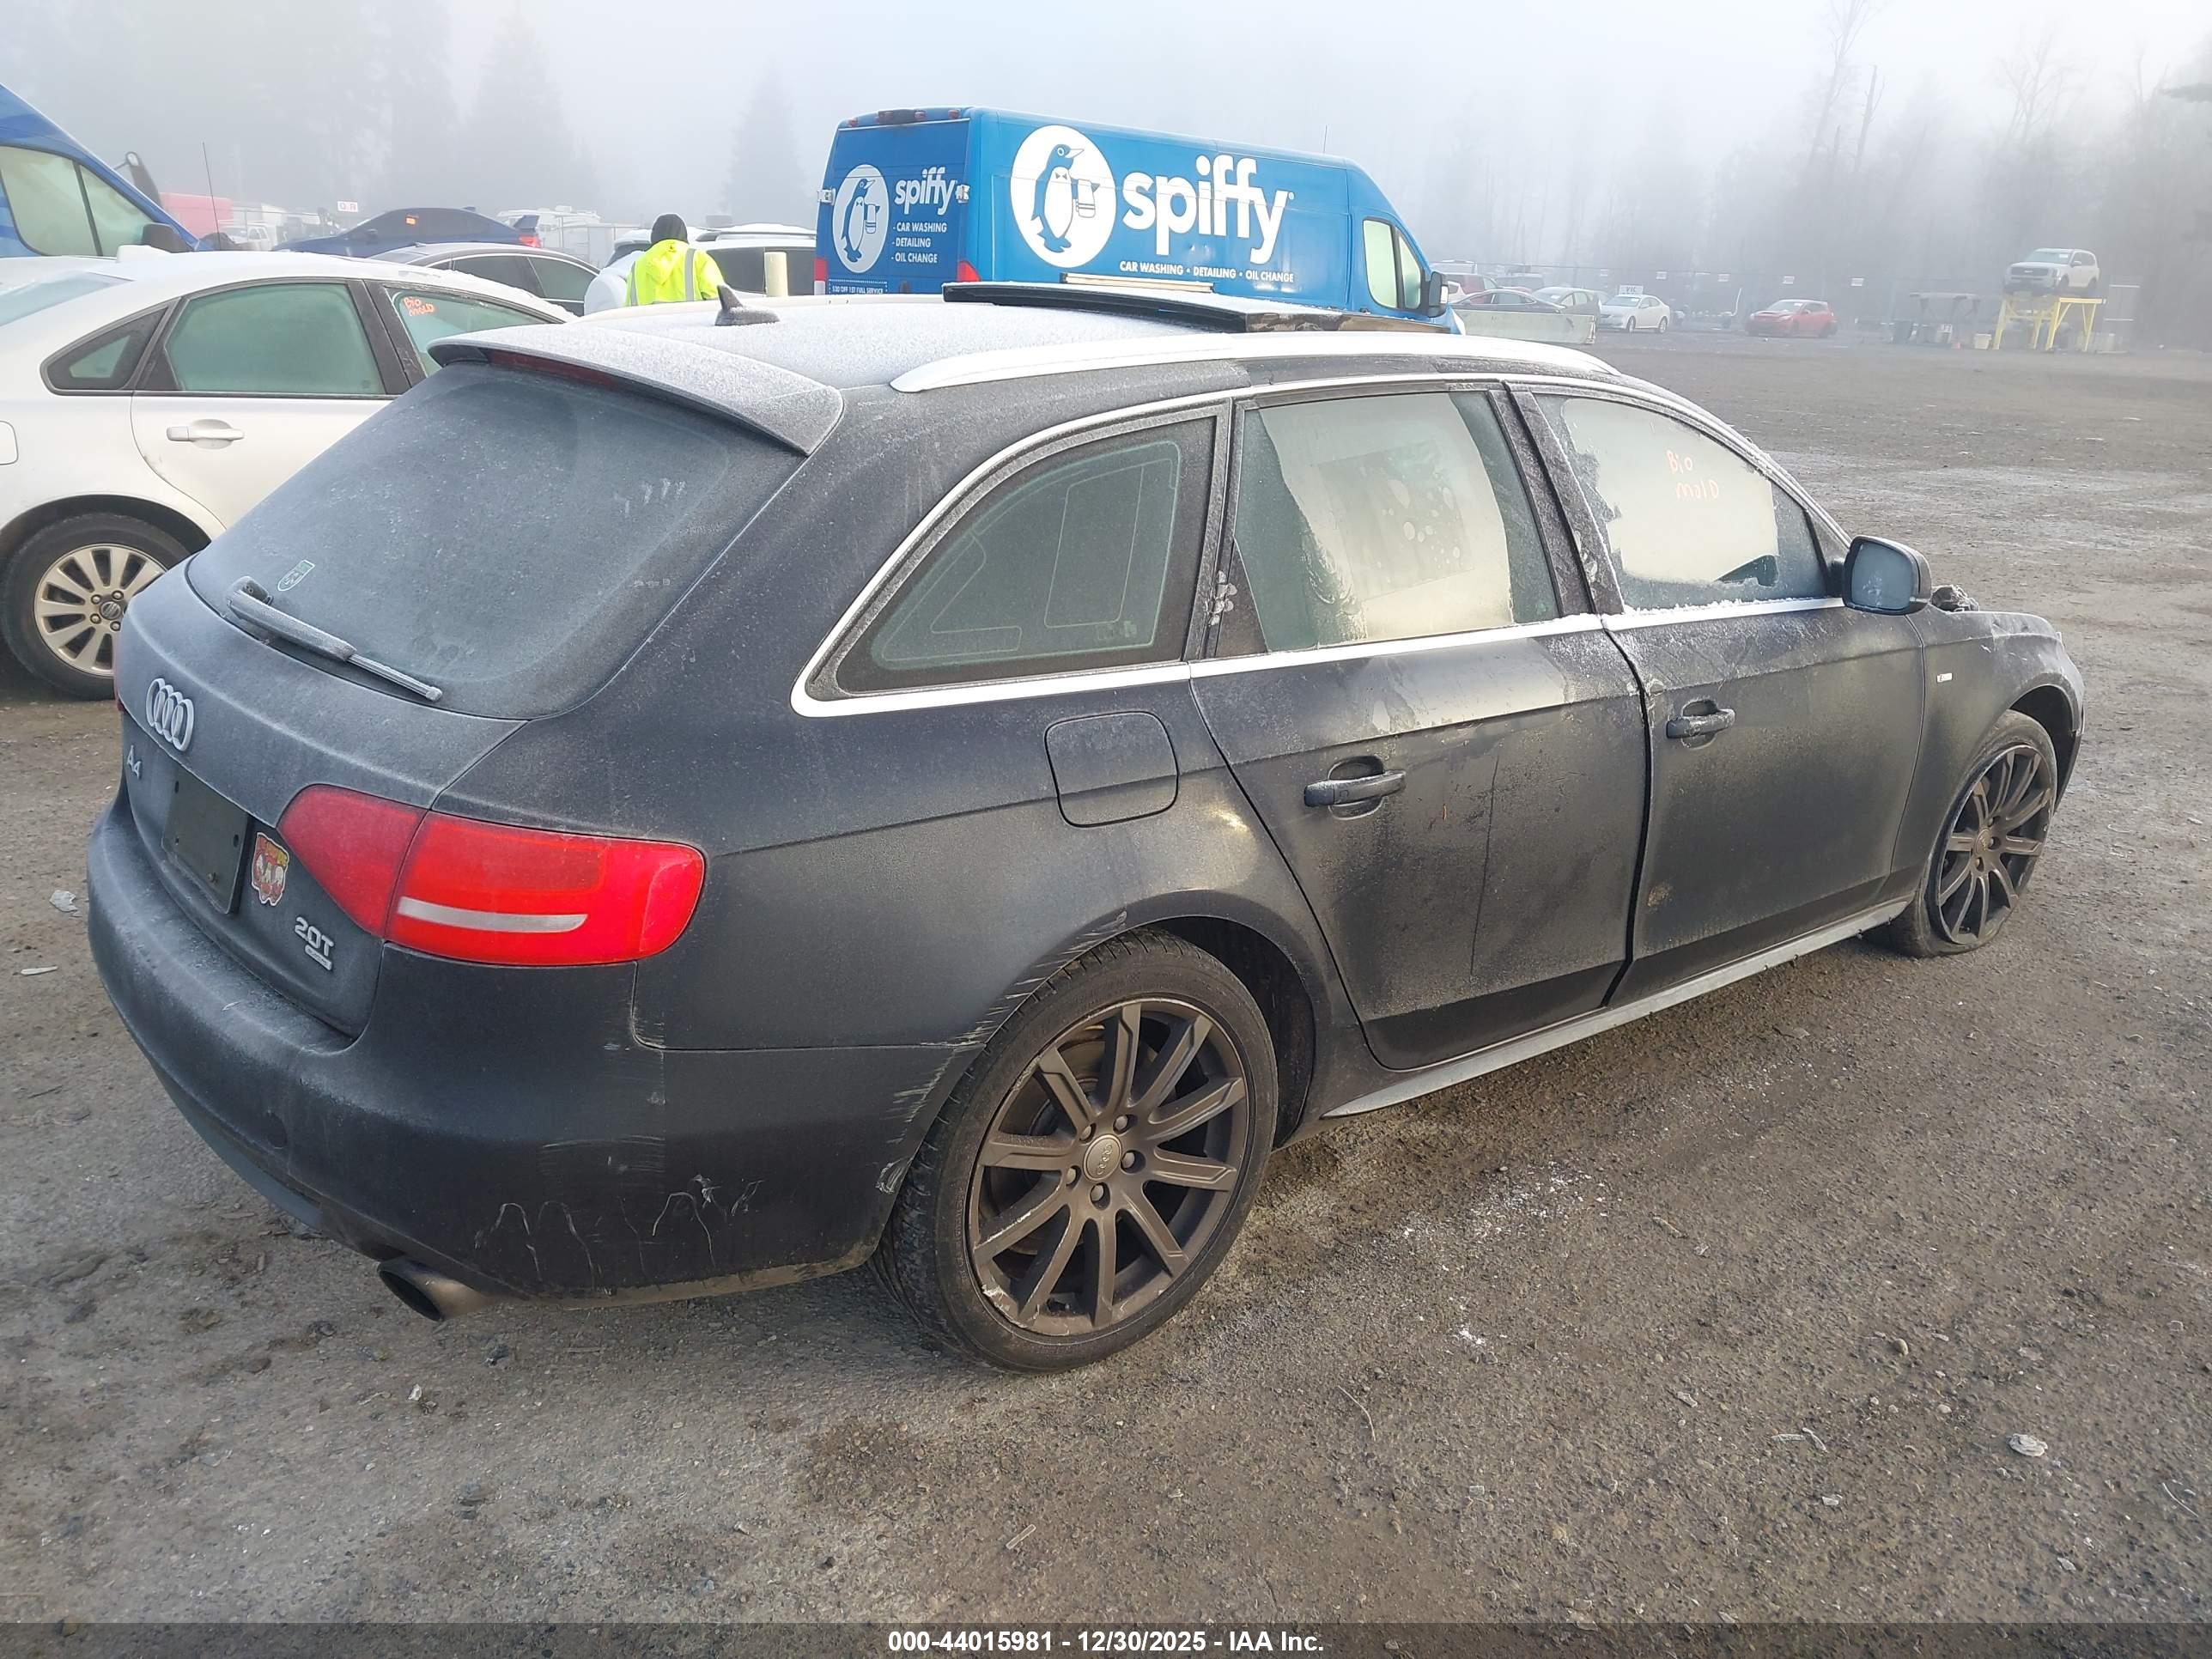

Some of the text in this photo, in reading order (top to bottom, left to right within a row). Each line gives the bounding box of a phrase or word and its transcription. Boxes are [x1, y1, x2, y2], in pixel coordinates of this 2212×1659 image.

[894, 167, 955, 216] spiffy
[1122, 154, 1288, 264] spiffy
[896, 222, 947, 233] CAR WASHING
[896, 238, 931, 247] DETAILING
[895, 252, 938, 264] OIL CHANGE
[1119, 260, 1294, 283] CAR WASHING DETAILING OIL CHANGE
[126, 744, 143, 780] A4
